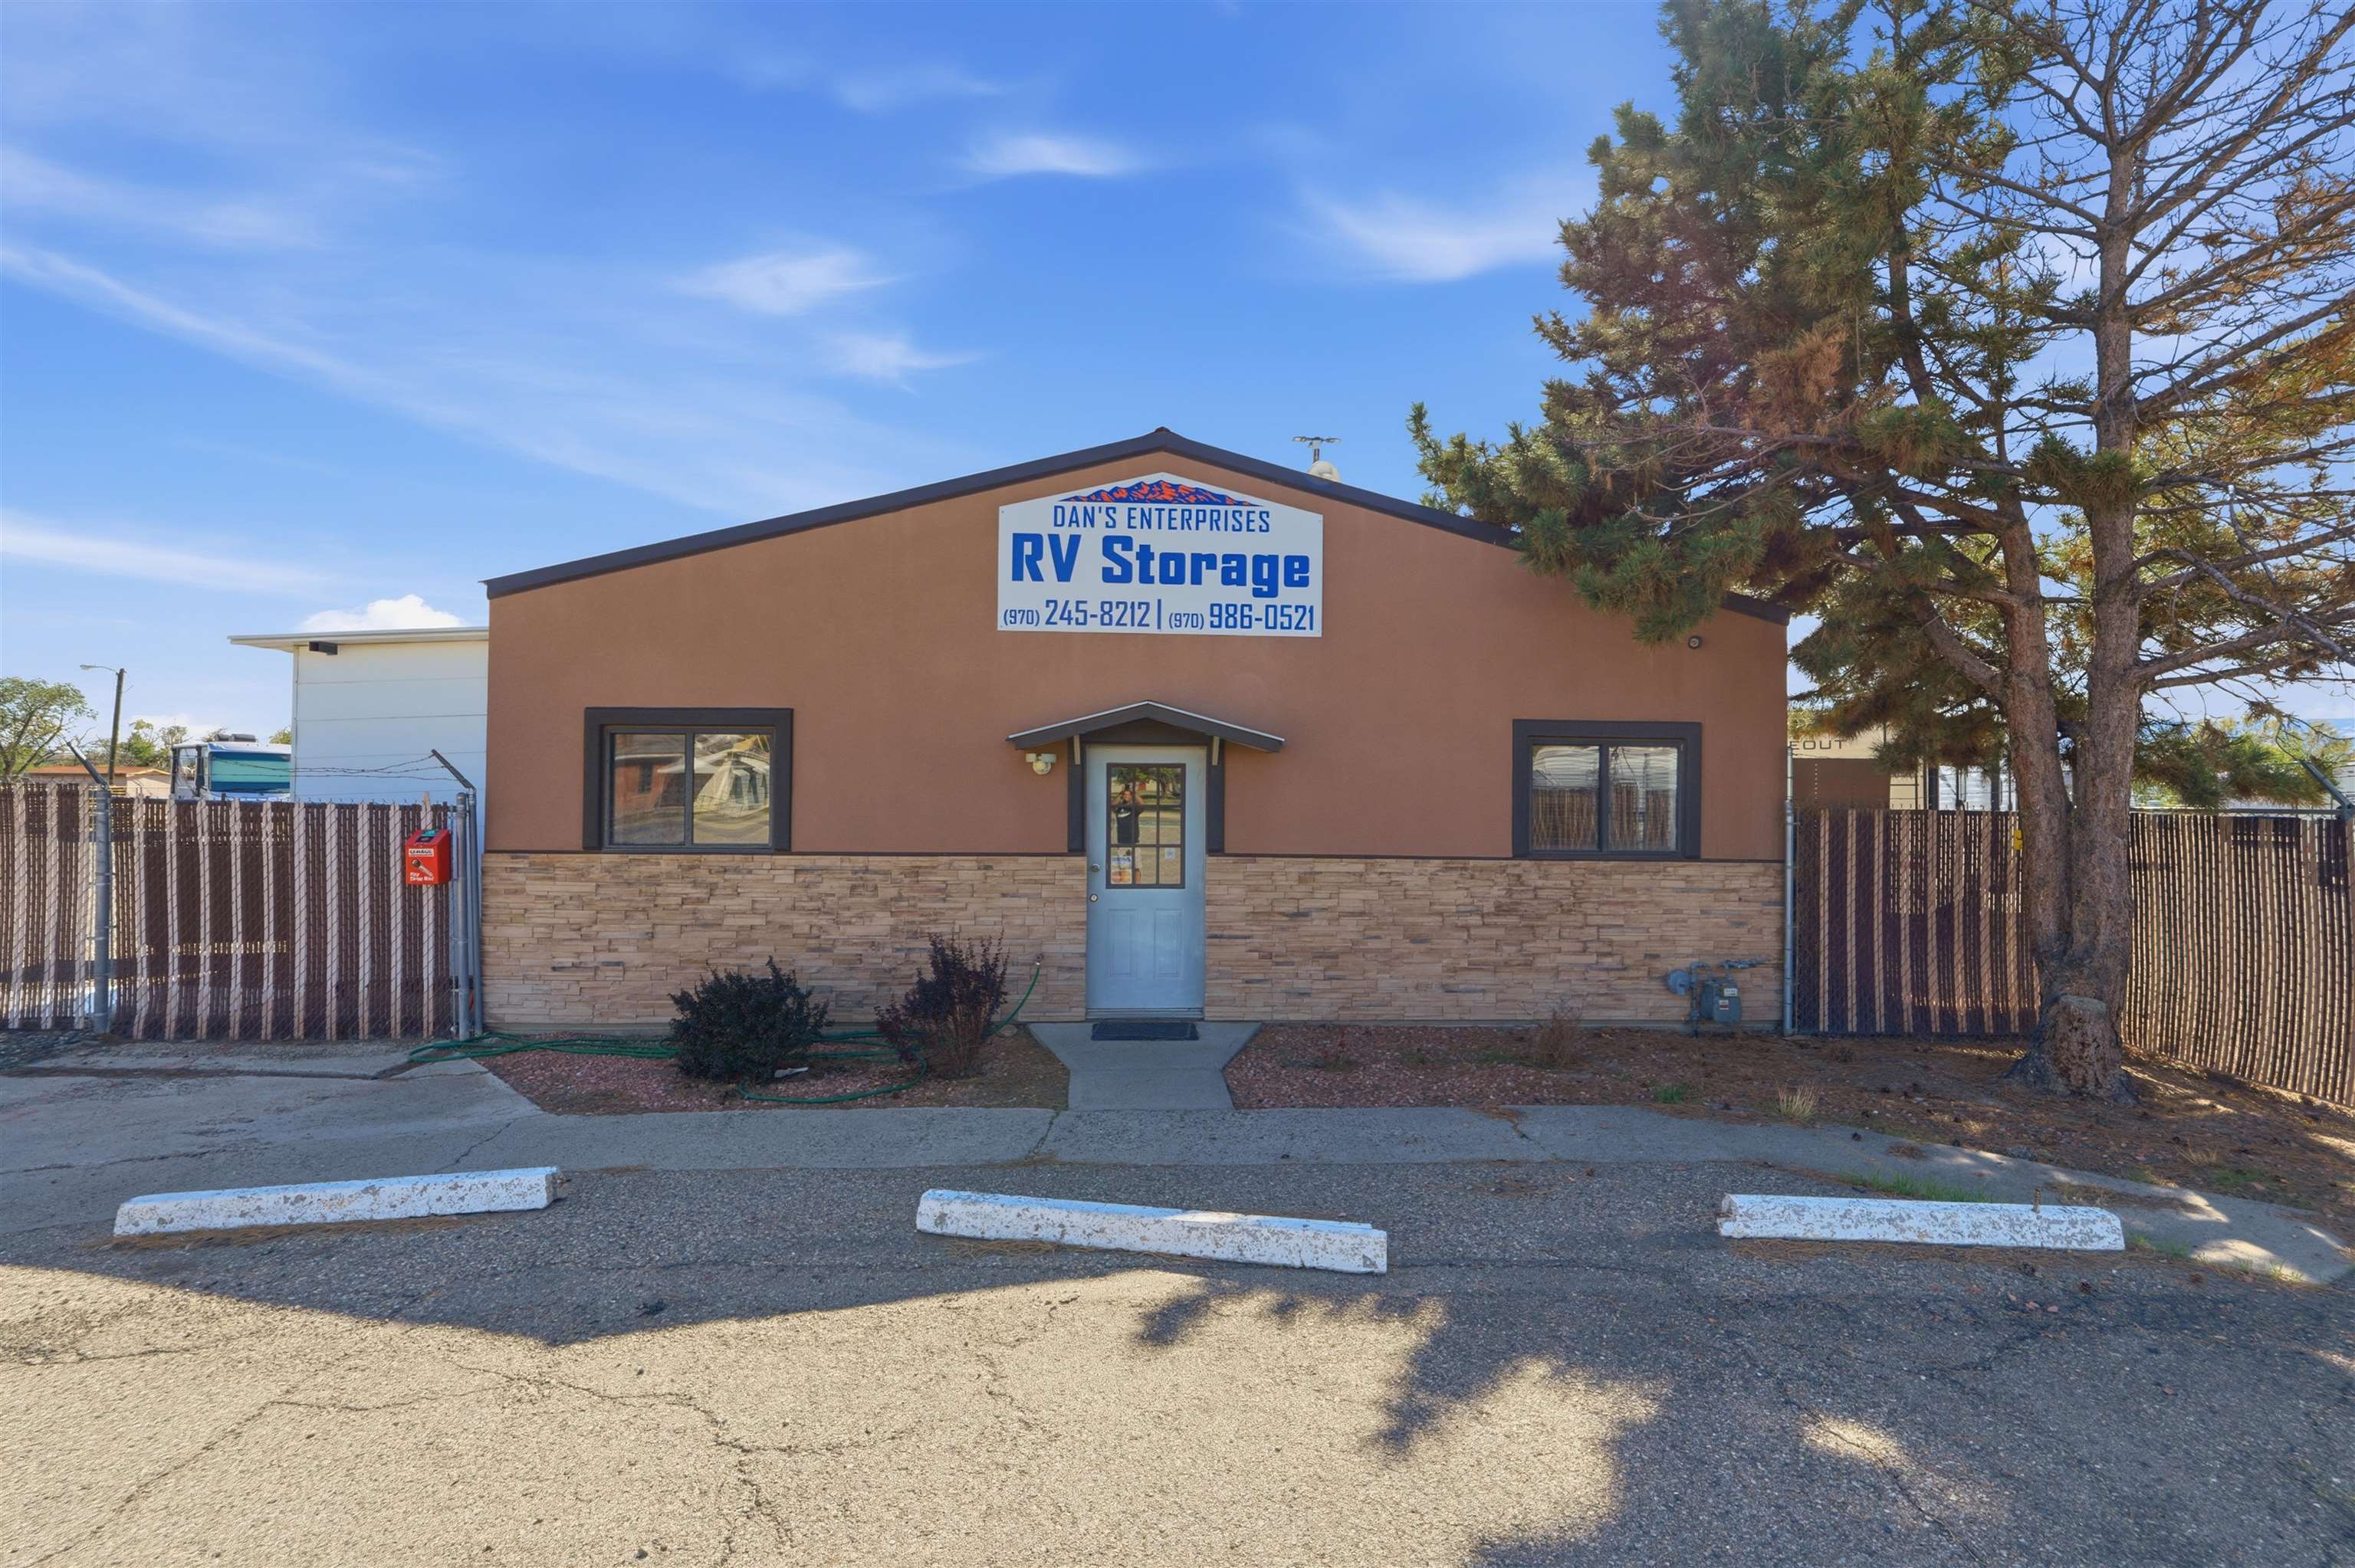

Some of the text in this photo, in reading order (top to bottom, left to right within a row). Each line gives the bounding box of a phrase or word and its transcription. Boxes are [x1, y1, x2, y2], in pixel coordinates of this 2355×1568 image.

[1053, 504, 1270, 533] DAN'S ENTERPRISES
[1011, 532, 1310, 599] RV Storage
[1003, 599, 1151, 628] (970) 245-8212
[1168, 602, 1314, 631] (970) 986-0521
